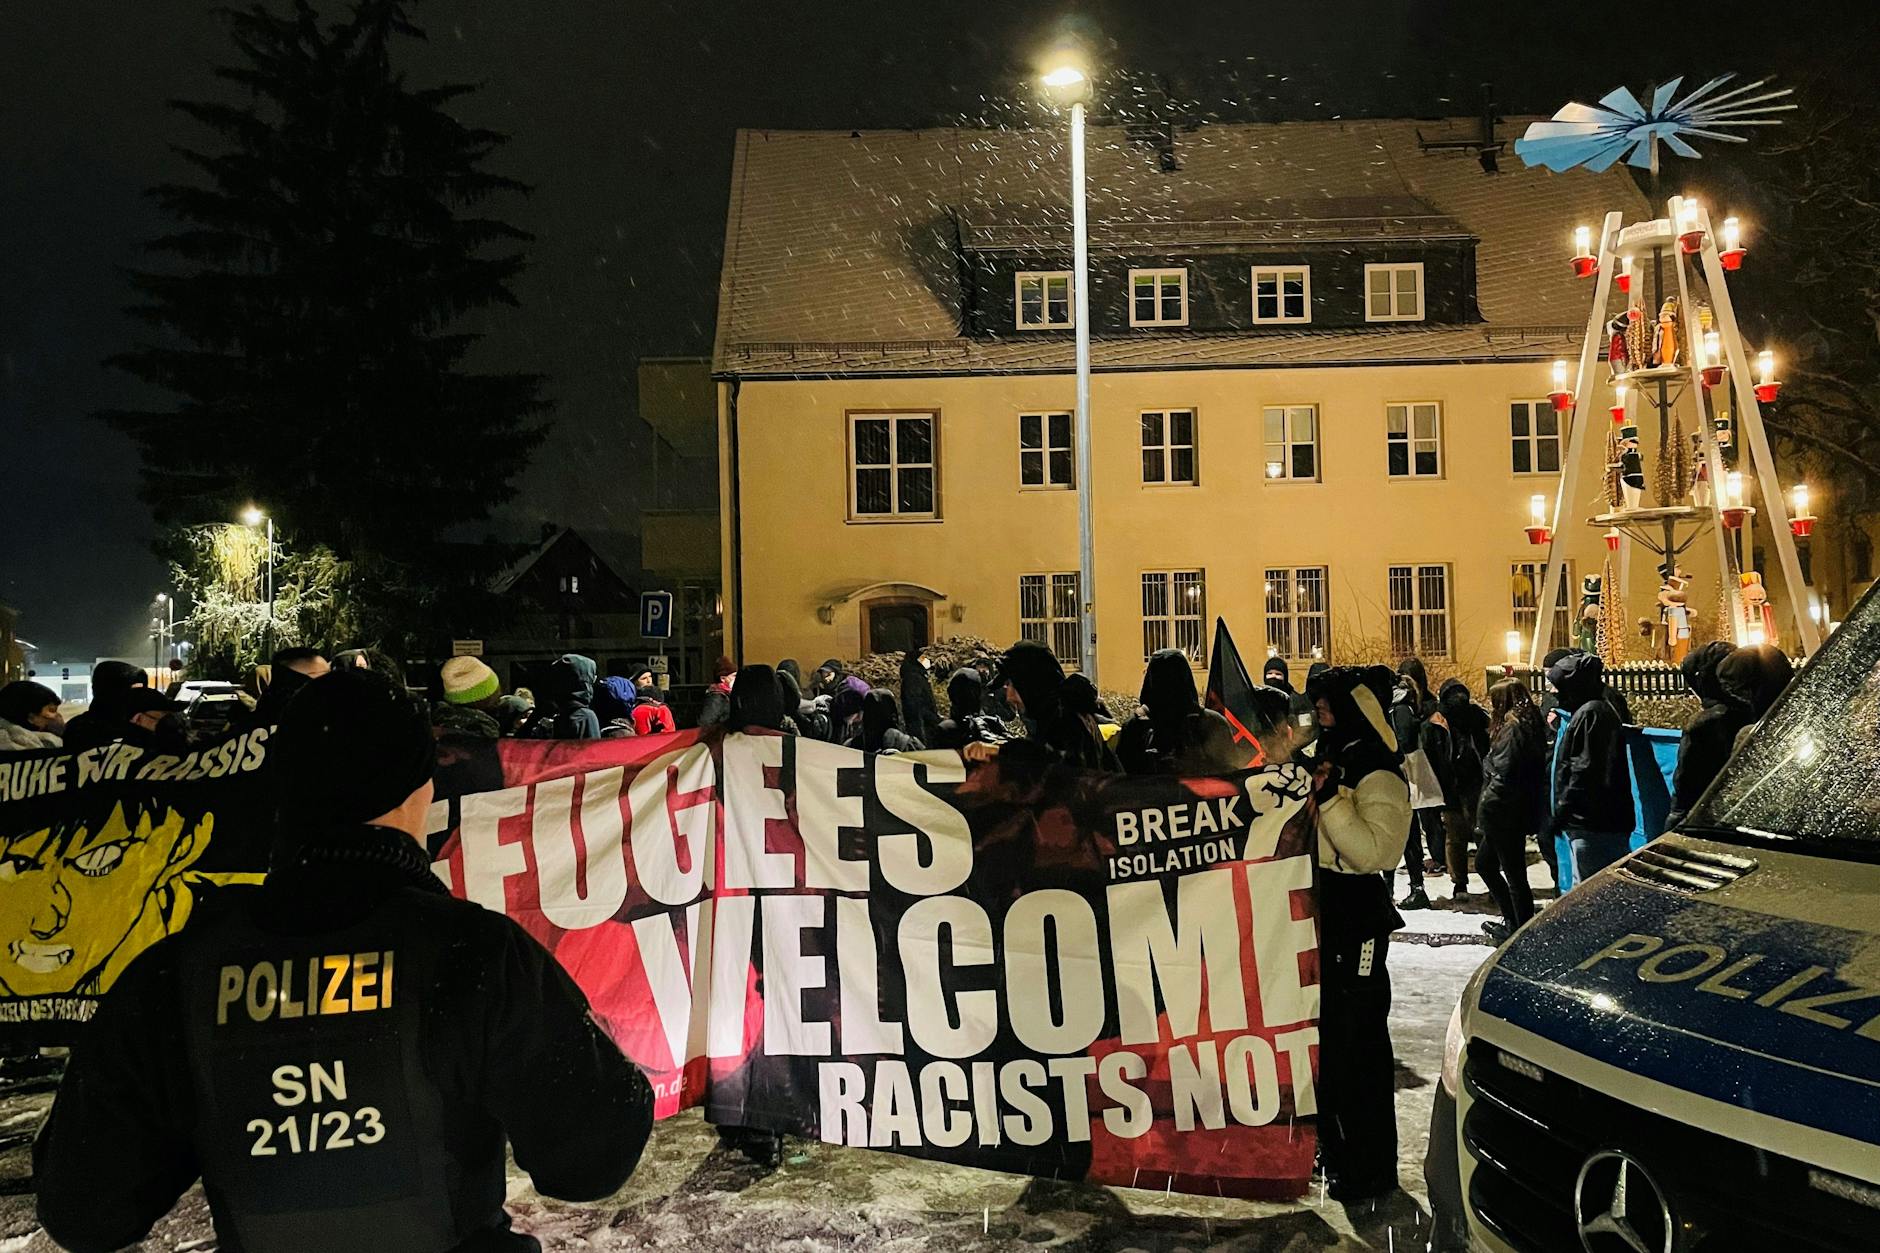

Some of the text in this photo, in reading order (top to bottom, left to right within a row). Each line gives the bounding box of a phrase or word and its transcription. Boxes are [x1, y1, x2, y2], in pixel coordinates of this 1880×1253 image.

[647, 599, 663, 632] P
[135, 725, 277, 781] RASSIS
[1116, 796, 1244, 847] BREAK
[1109, 837, 1236, 879] ISOLATION
[217, 950, 394, 1025] POLIZEI
[631, 854, 1320, 1068] WELCOME
[1576, 933, 1880, 1041] POLIZ
[271, 1060, 347, 1106] SN
[818, 1026, 1319, 1148] RACISTS NOT
[246, 1106, 386, 1156] 21/23
